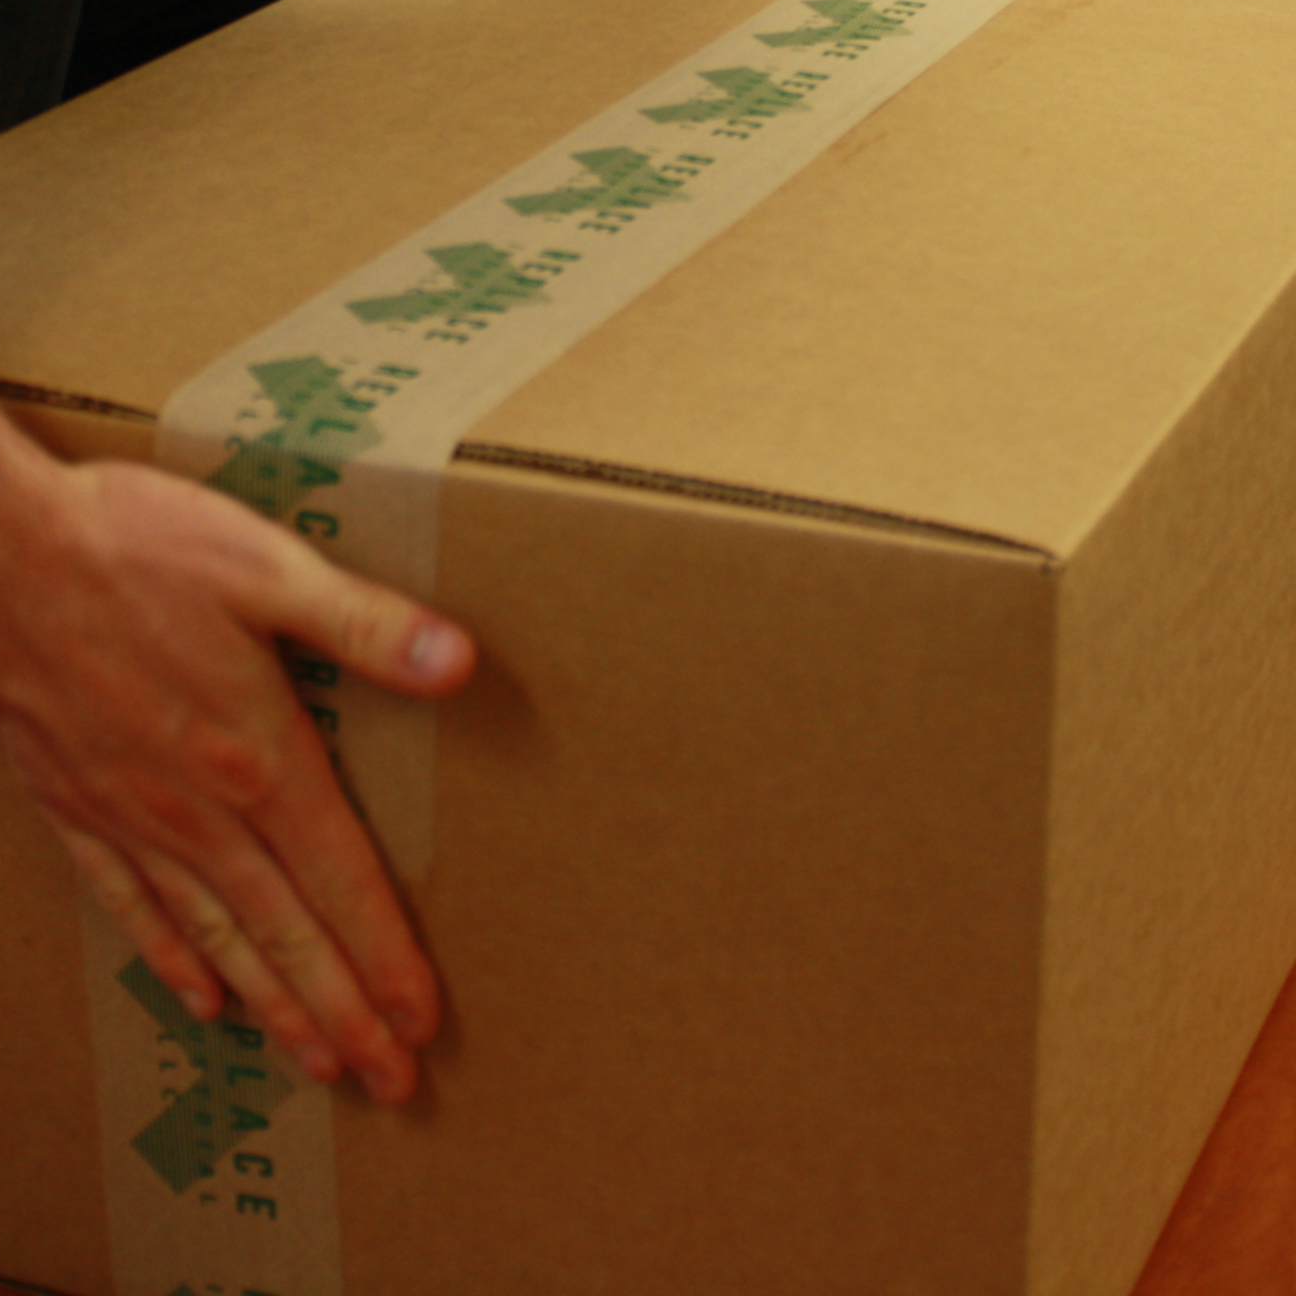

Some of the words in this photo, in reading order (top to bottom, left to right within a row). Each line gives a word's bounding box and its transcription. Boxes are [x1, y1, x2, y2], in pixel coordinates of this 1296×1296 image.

[822, 0, 927, 60] REPLACE
[712, 70, 831, 140] REPLACE
[578, 153, 716, 234] REPLACE
[424, 250, 582, 345] REPLACE
[295, 363, 421, 539] REPLAC
[220, 1023, 278, 1221] PLACE
